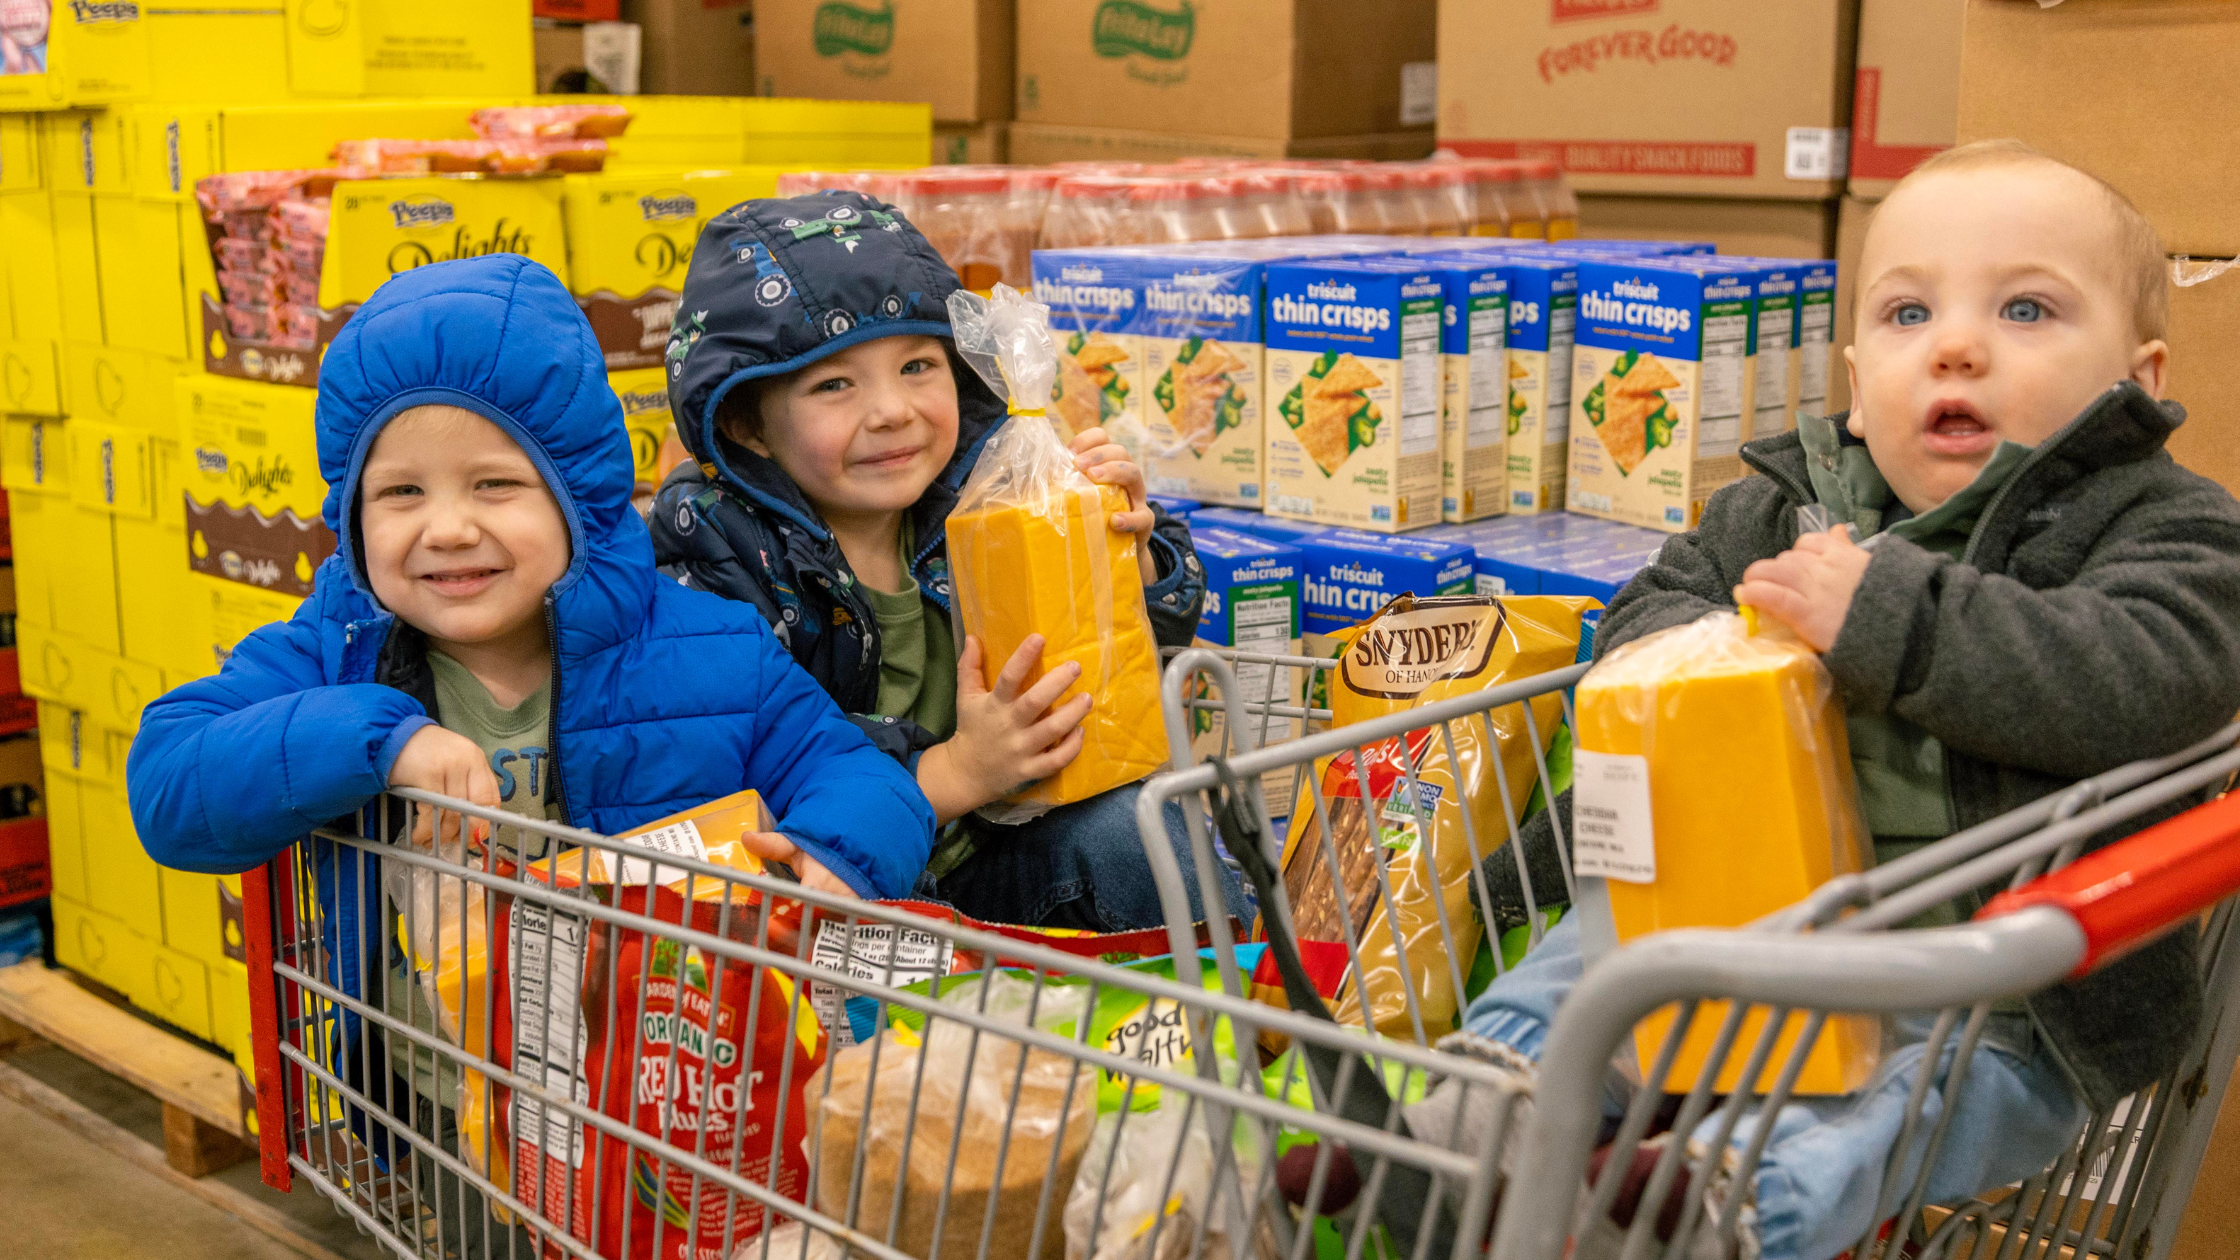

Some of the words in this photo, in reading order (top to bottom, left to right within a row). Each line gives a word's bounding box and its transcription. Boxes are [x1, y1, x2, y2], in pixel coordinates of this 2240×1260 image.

[1537, 29, 1658, 84] FOREVER
[1658, 23, 1738, 68] GOOD
[389, 199, 454, 229] Peeps
[1035, 277, 1073, 305] thin
[1073, 285, 1134, 311] crisps
[1146, 280, 1185, 311] thin
[1186, 290, 1251, 319] crisps
[1307, 282, 1357, 302] triscuit
[1613, 280, 1660, 302] triscuit
[1272, 293, 1320, 325] thin
[1321, 303, 1391, 334] crisps
[1581, 290, 1624, 323] thin
[1624, 302, 1691, 335] crisps
[1232, 567, 1258, 582] thin
[1258, 565, 1294, 580] crisps
[1330, 564, 1384, 587] triscuit
[1303, 573, 1342, 607] hin
[1345, 587, 1398, 613] cris
[1385, 670, 1403, 683] OF
[1386, 802, 1431, 818] VERIFD
[512, 911, 547, 931] Clorie
[900, 927, 938, 945] Fact
[871, 941, 885, 952] per
[645, 1012, 737, 1067] ORANC
[1106, 1004, 1183, 1053] good
[638, 1056, 681, 1105] RED
